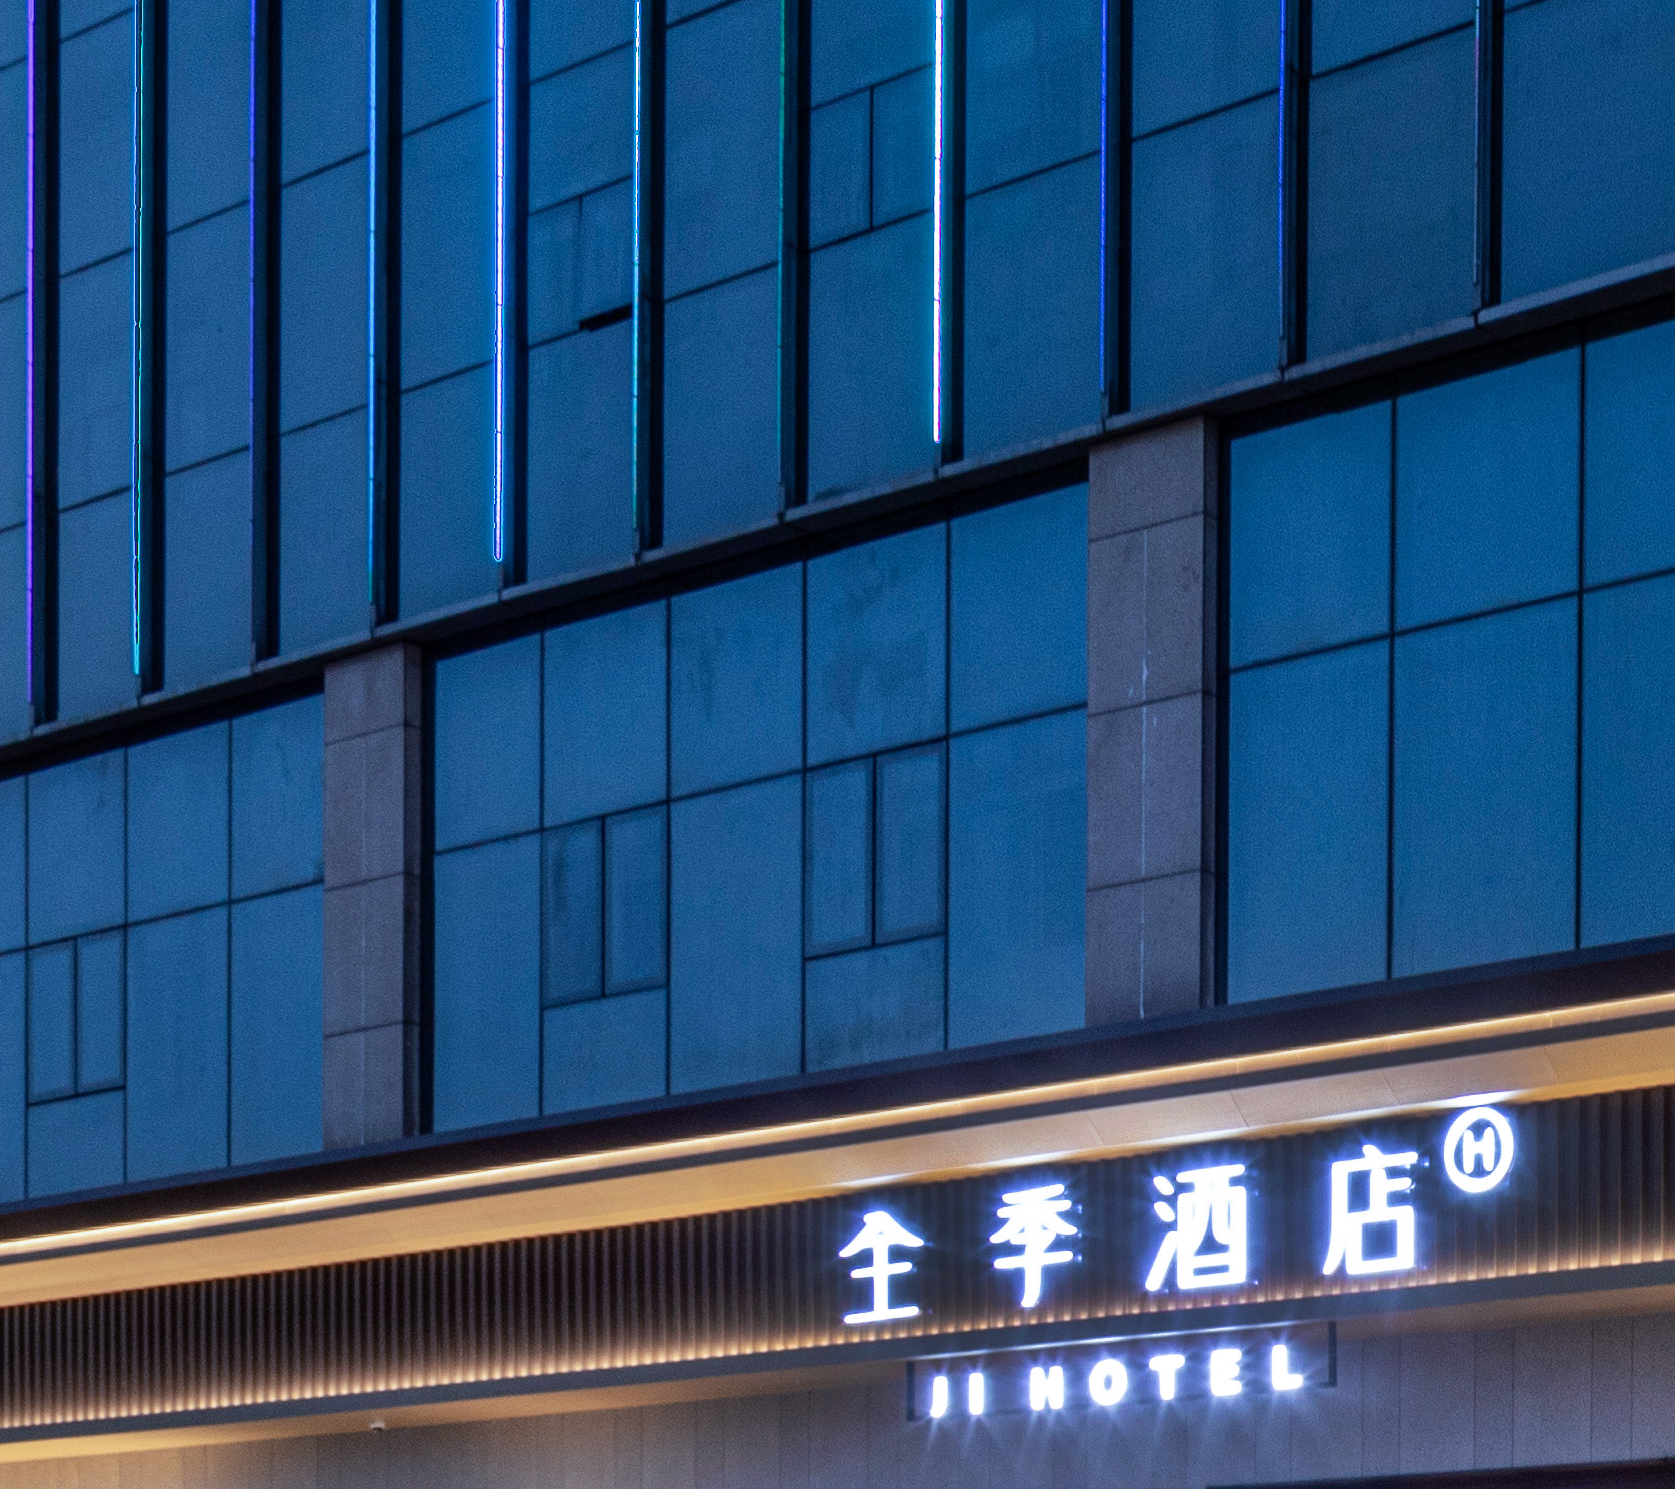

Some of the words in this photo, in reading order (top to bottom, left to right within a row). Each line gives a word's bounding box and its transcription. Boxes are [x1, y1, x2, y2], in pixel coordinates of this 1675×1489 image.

[838, 1144, 1419, 1325] 全季酒店
[929, 1373, 985, 1419] JI
[1028, 1343, 1304, 1411] HOTEL
